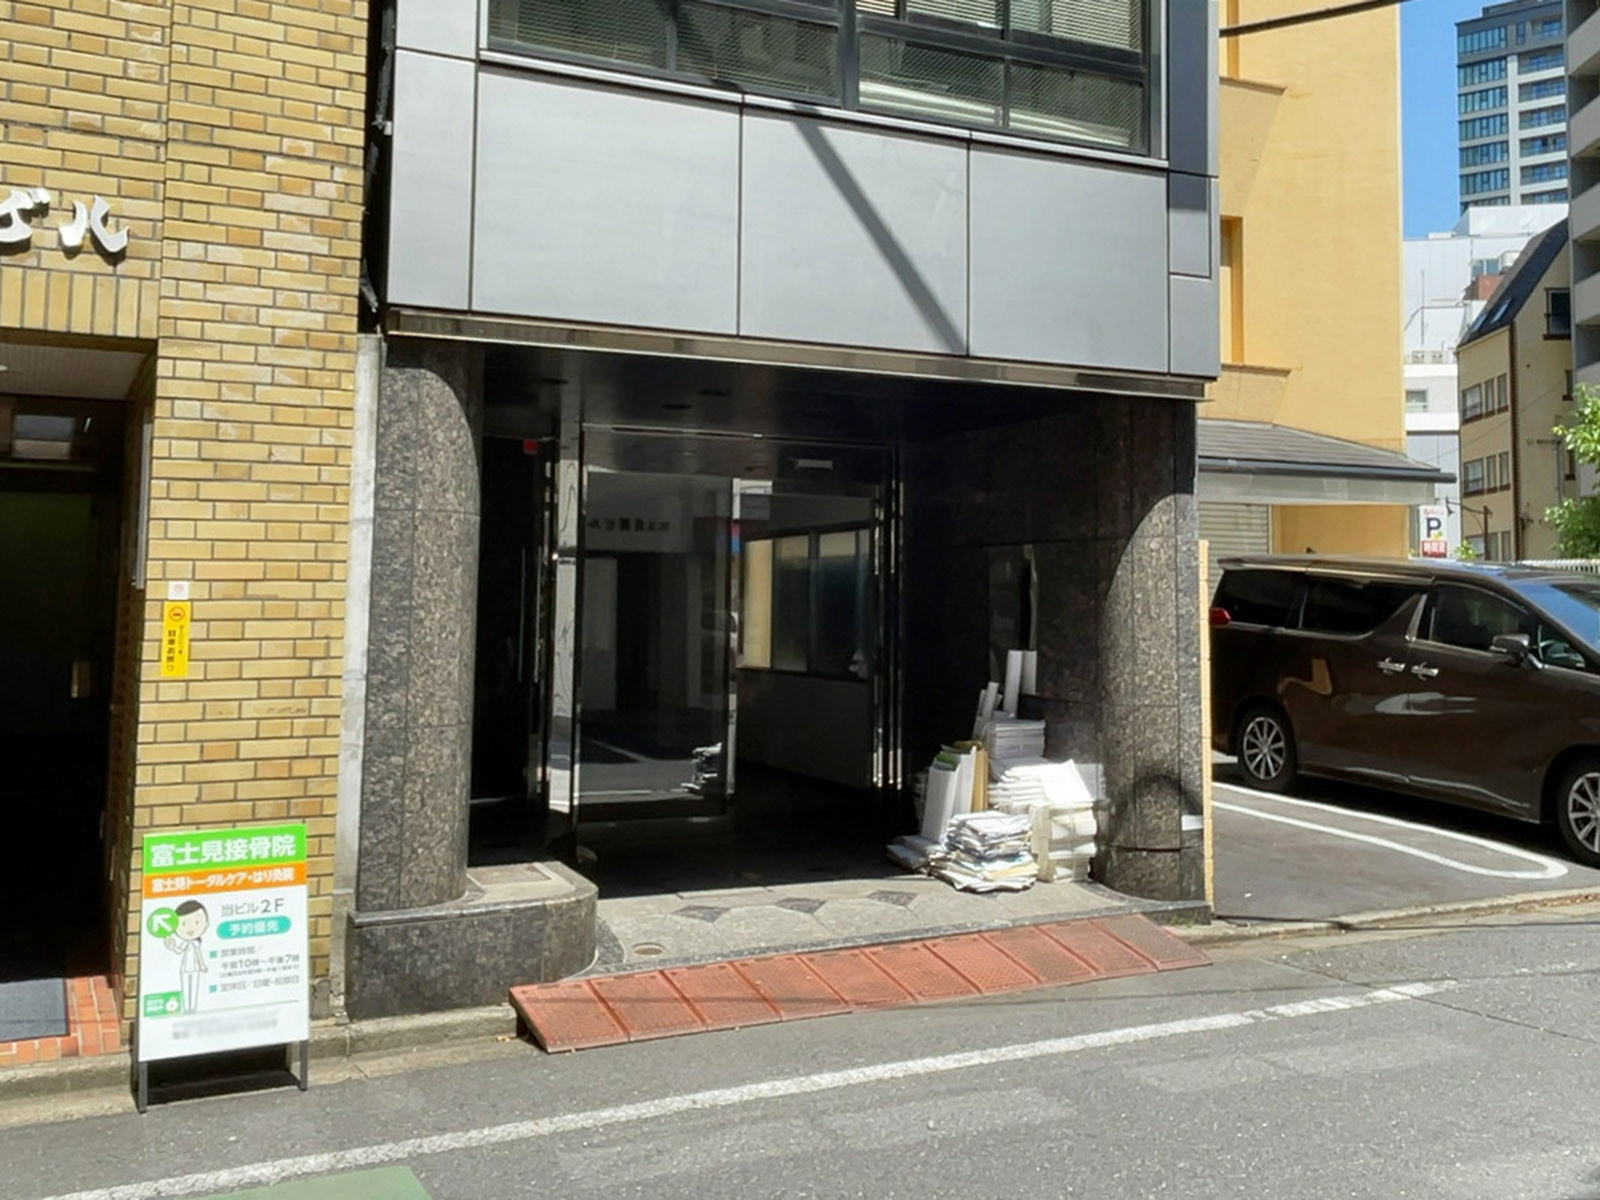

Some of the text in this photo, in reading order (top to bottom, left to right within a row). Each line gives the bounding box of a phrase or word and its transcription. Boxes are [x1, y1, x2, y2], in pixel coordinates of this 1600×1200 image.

[1426, 517, 1442, 538] P
[151, 834, 296, 868] 富士見接骨院
